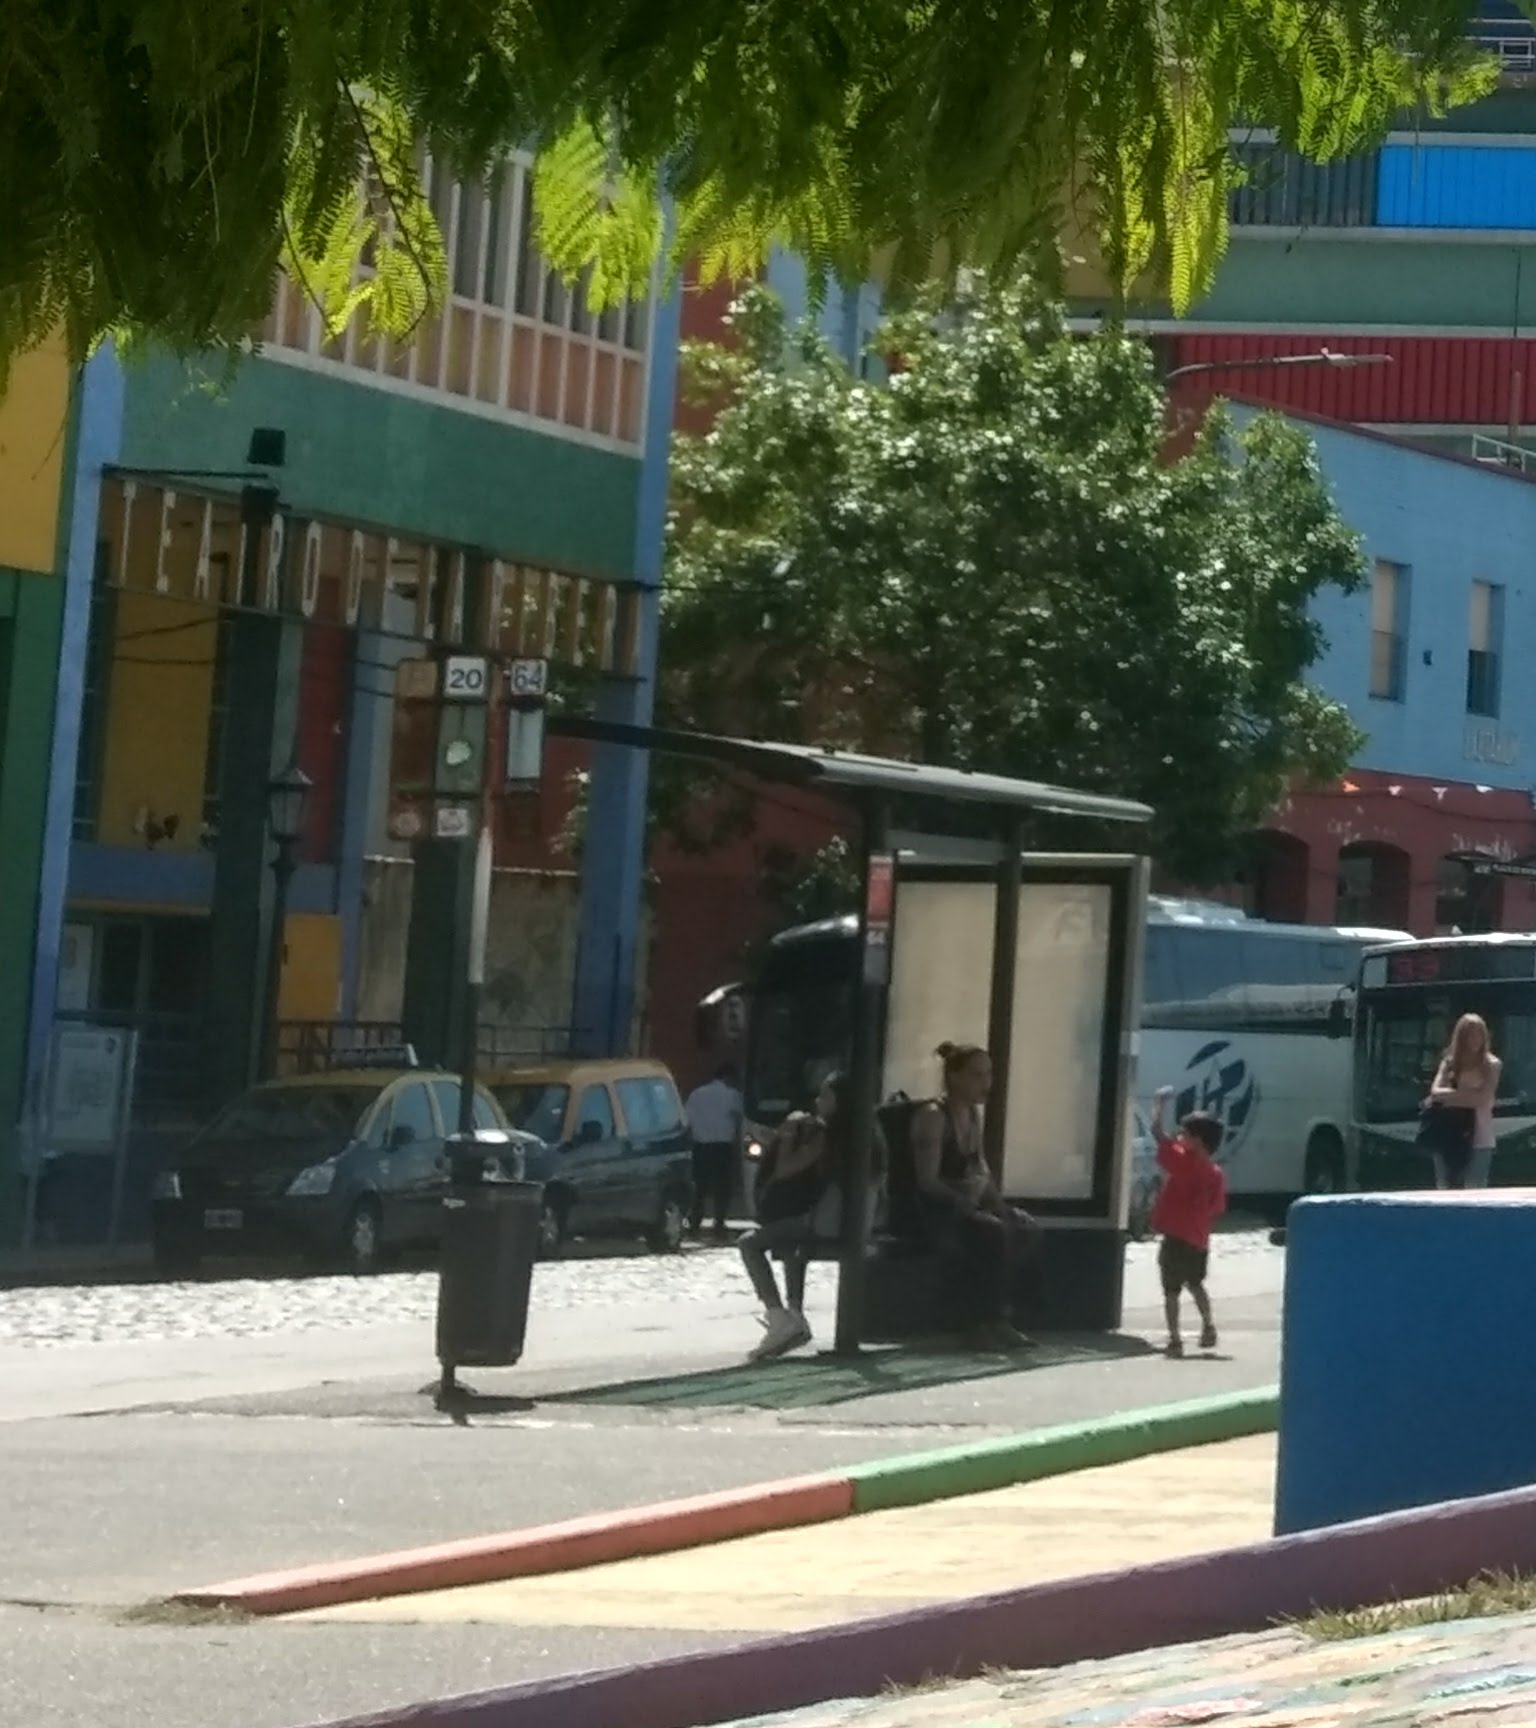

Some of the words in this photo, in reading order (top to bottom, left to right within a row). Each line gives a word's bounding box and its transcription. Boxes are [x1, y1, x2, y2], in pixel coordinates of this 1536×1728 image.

[121, 479, 322, 619] TEATRO
[346, 529, 399, 632] DE
[451, 668, 483, 689] 20
[514, 664, 543, 689] 64
